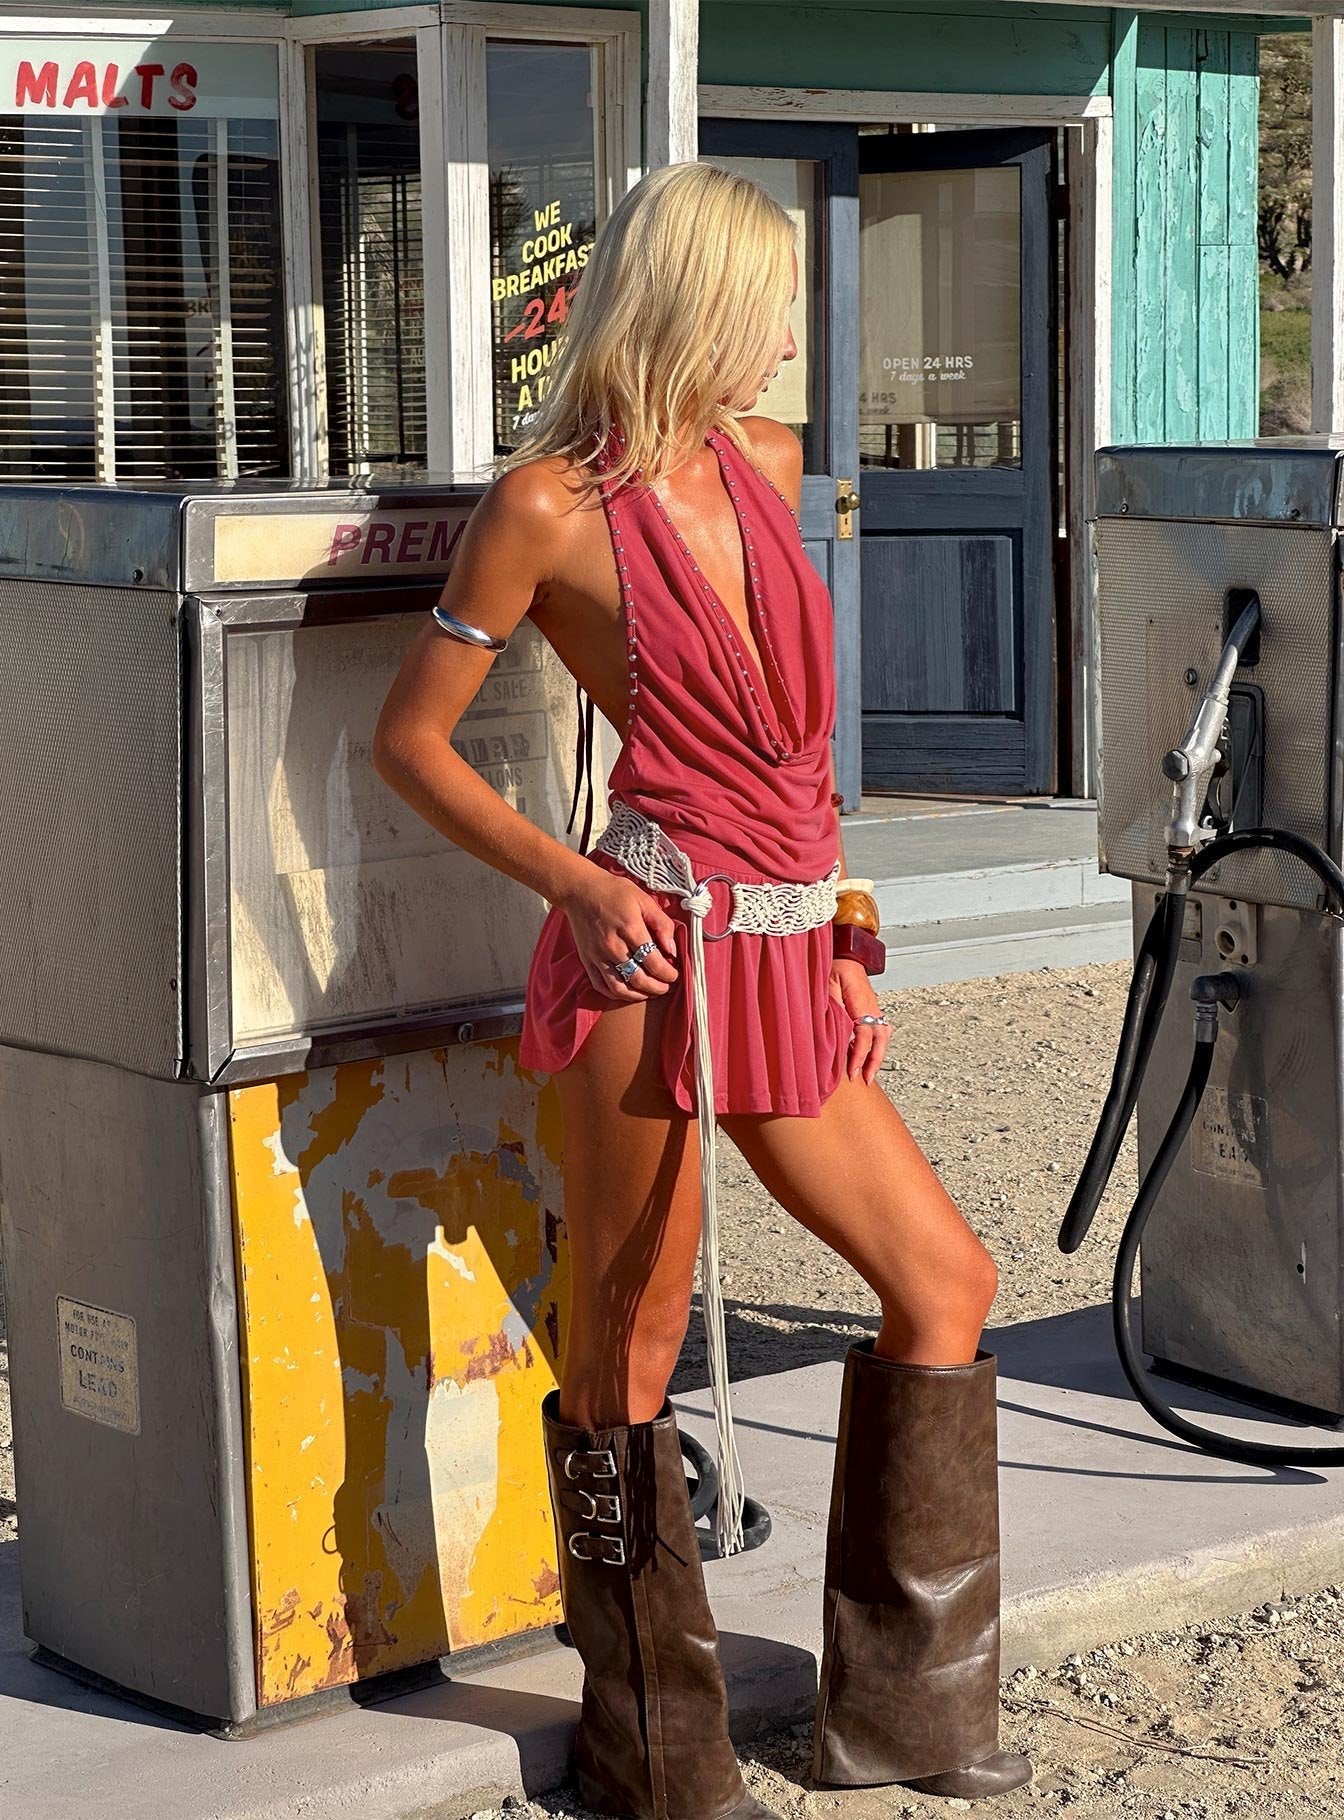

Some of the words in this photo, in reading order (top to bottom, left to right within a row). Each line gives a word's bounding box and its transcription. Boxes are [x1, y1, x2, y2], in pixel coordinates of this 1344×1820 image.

[15, 60, 199, 111] MALTS
[534, 200, 561, 232] WE
[521, 222, 573, 264] COOK
[882, 357, 920, 370] OPEN
[923, 356, 942, 369] 24
[945, 355, 974, 369] HRS
[890, 370, 896, 381] 7
[899, 371, 924, 386] days
[928, 373, 937, 381] a
[940, 370, 966, 381] week
[517, 384, 533, 412] A
[493, 679, 528, 701] SALE
[64, 1321, 89, 1338] MOTOR
[78, 1370, 118, 1399] LEAD
